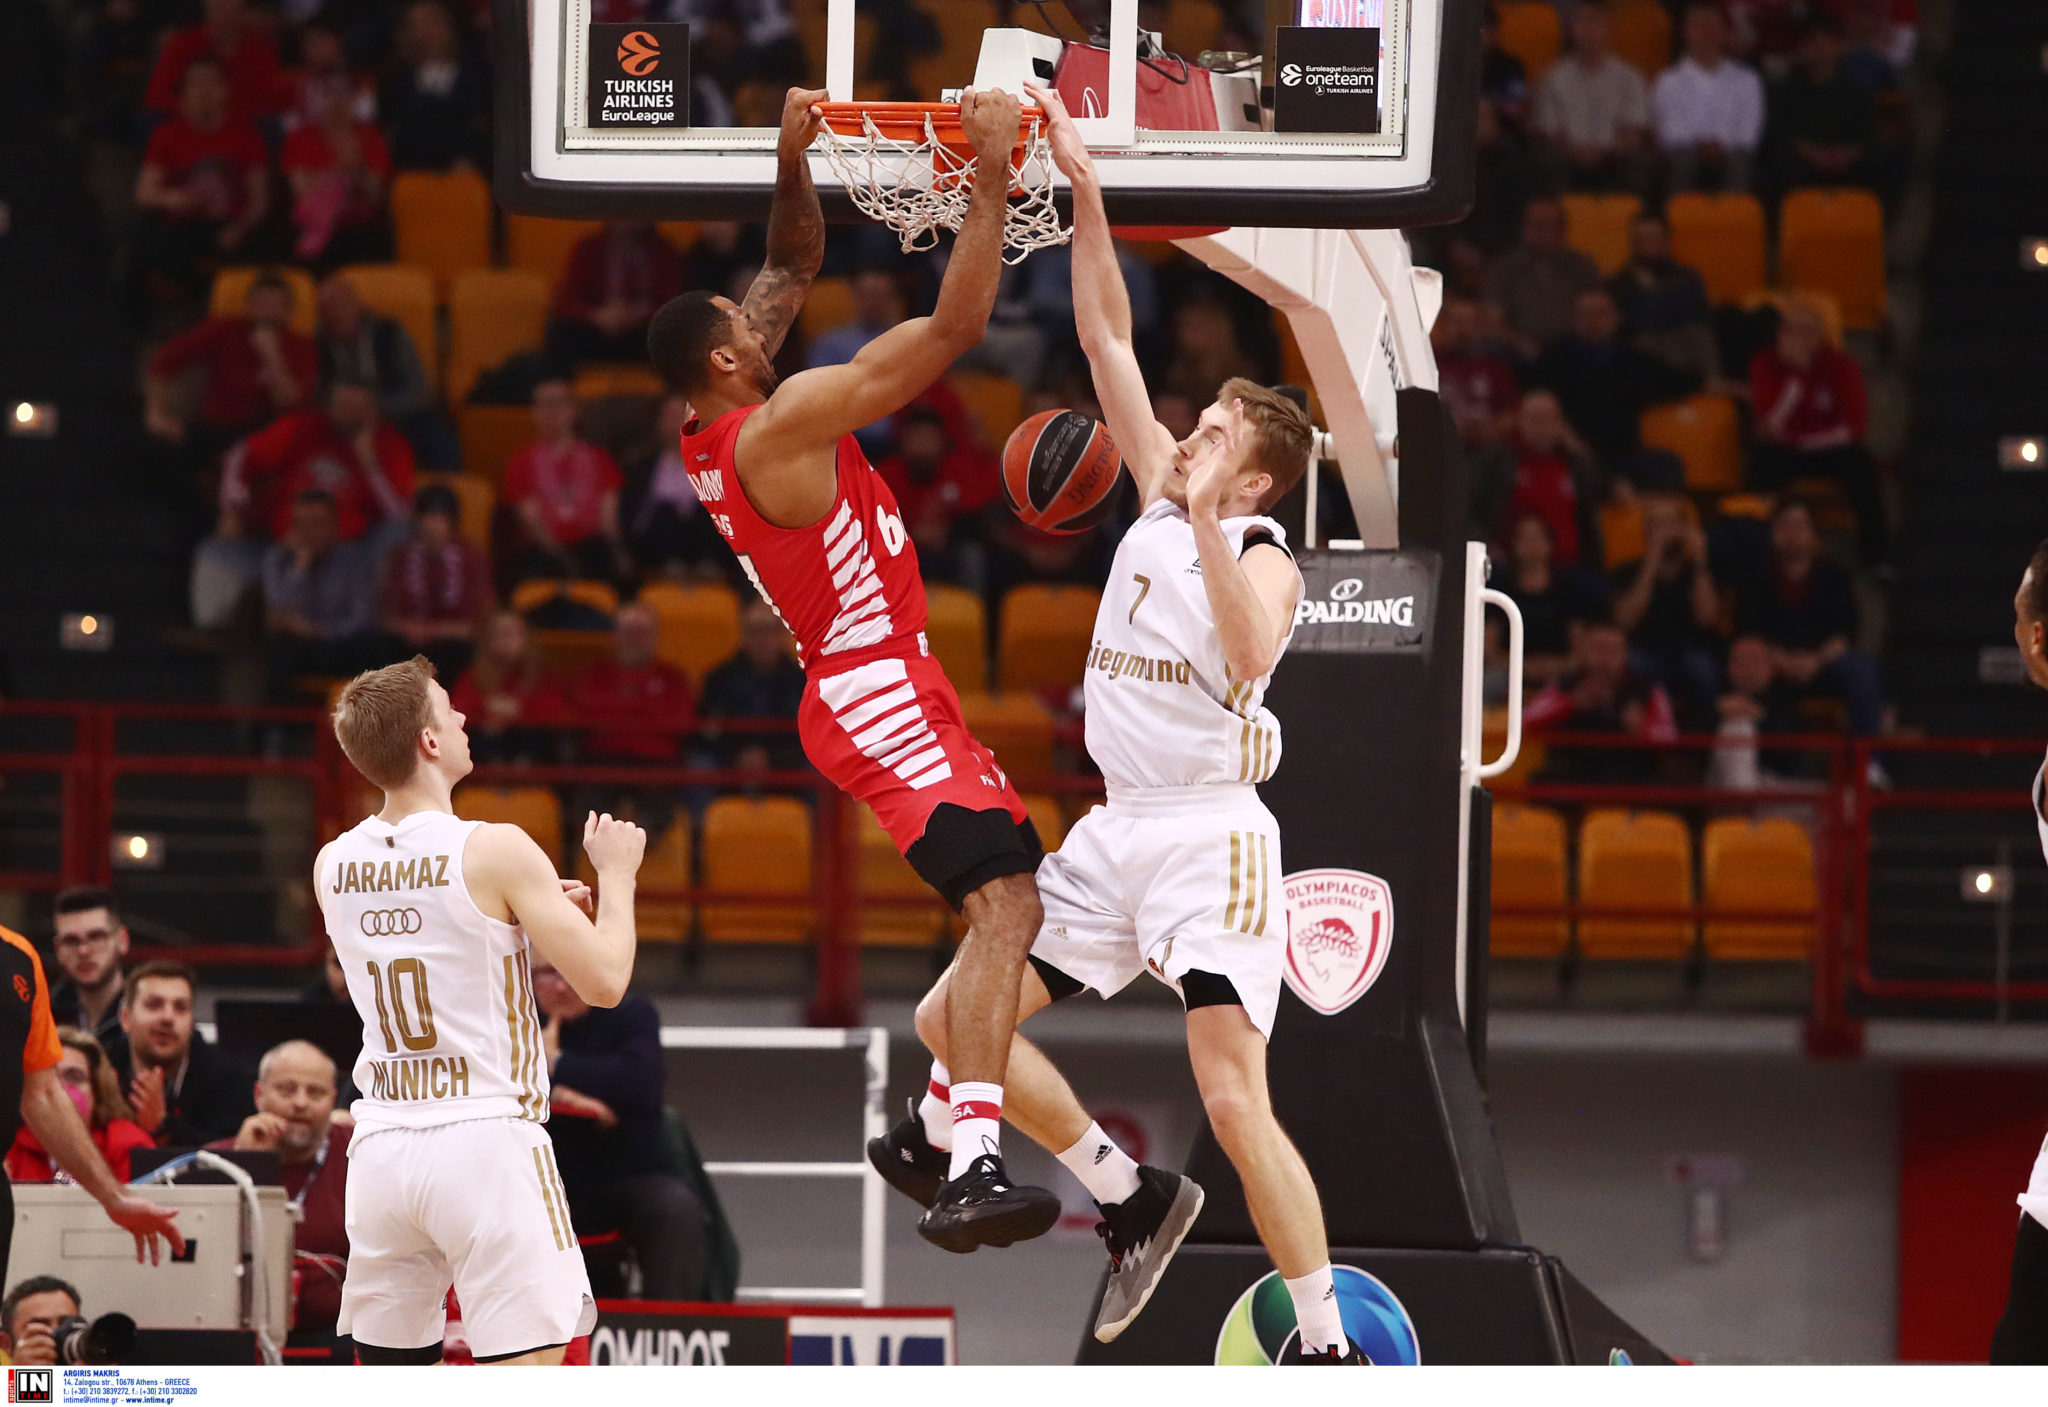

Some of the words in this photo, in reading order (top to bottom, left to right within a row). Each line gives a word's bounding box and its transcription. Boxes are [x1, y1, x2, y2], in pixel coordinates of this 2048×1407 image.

[1305, 65, 1341, 74] Euroleague
[1342, 65, 1375, 73] Basketball
[604, 80, 673, 93] TURKISH
[1305, 73, 1374, 86] oneteam
[603, 94, 674, 108] AIRLINES
[602, 110, 675, 125] EuroLeague
[1128, 572, 1151, 625] 7
[1296, 596, 1415, 627] PALDING
[332, 854, 450, 895] JARAMAZ
[1286, 881, 1378, 901] OLYMPIACOS
[1299, 896, 1364, 911] BASKETBALL
[366, 957, 438, 1053] 10
[368, 1056, 469, 1101] MUNICH
